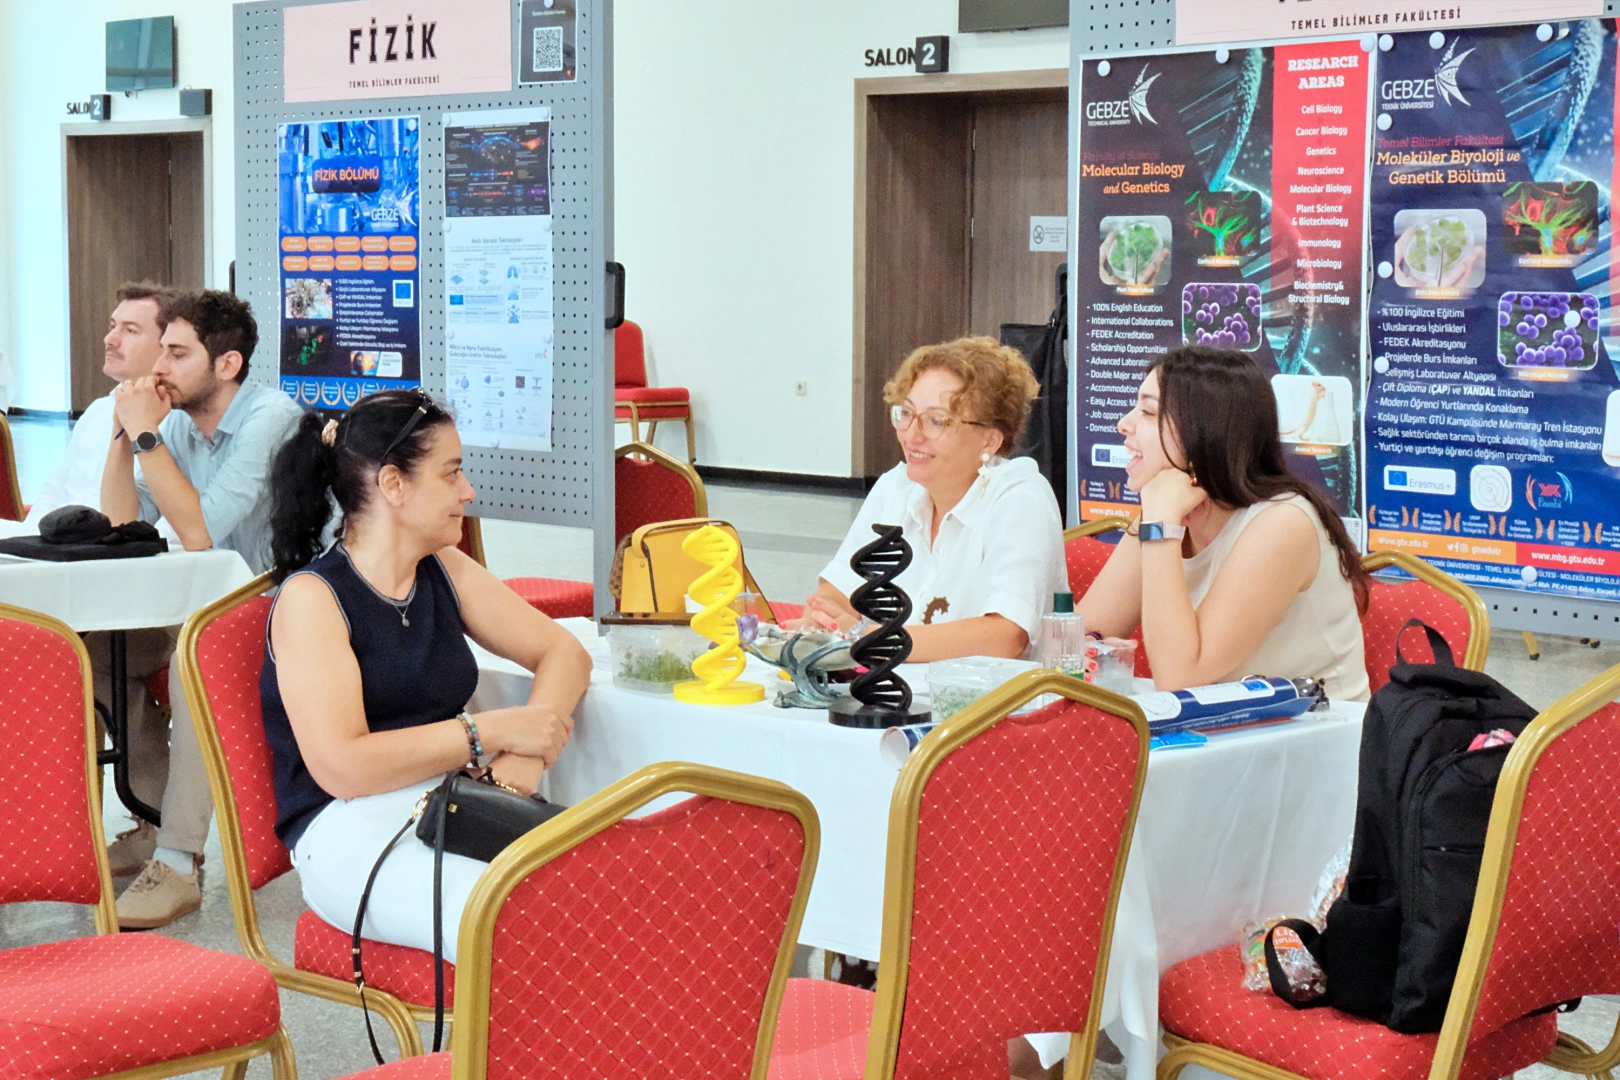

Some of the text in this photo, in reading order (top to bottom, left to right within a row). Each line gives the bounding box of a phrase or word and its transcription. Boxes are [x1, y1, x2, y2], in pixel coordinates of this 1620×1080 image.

[1291, 6, 1462, 30] TEMEL BİLİMLER FAKÜLTESİ
[349, 14, 438, 65] FİZİK
[864, 42, 936, 67] SALON 2
[1287, 55, 1359, 71] RESEARCH
[349, 75, 440, 88] TEMEL BİLİMLER FAKÜLTESİ
[1298, 75, 1345, 89] AREAS
[1381, 79, 1435, 100] GEBZE
[66, 98, 101, 116] SALO 2
[1086, 101, 1130, 119] GEBZE
[1301, 104, 1342, 114] Cell Biology
[1382, 100, 1434, 110] TEKNİK ÜNİVERSİTESİ
[1296, 126, 1348, 136] Cancer Biology
[1378, 134, 1504, 149] Temel Bilimler Fakültesi
[1306, 146, 1336, 156] Genetics
[1376, 148, 1521, 166] Moleküler Biyoloji ve
[315, 166, 380, 181] FİZİK BÖLÜMÜ
[1082, 162, 1185, 179] Molecular Biology
[1298, 166, 1344, 175] Neuroscience
[1389, 169, 1506, 185] Genetik Bölümü
[1103, 181, 1170, 194] and Genetics
[1290, 183, 1352, 194] Molecular Biology
[371, 208, 399, 221] GEBZE
[1296, 204, 1343, 213] Plant Science
[1291, 216, 1349, 227] & Biotechnology
[1298, 238, 1341, 248] Immunology
[1297, 259, 1342, 269] Microbiology
[1518, 257, 1541, 265] Konfokal
[1288, 294, 1350, 305] Structural Biology
[1092, 303, 1163, 313] 100% English Education
[1382, 306, 1465, 319] %100 İngilizce Eğitimi
[1091, 317, 1174, 327] International Collaborations
[1382, 321, 1466, 334] Uluslararası İşbirlikleri
[1114, 330, 1154, 339] Accreditation
[1091, 343, 1168, 354] Scholarship Opportunities
[1384, 337, 1466, 350] FEDEK Akreditasyonu
[1090, 356, 1120, 365] Advanced
[1385, 352, 1478, 365] Projelerde Burs İmkanları
[1090, 370, 1143, 380] Double Major and
[1416, 368, 1461, 380] Laboratuvar
[1463, 370, 1497, 382] Altyapısı
[1090, 383, 1138, 393] Accommodation
[1382, 382, 1395, 393] Çift
[1397, 382, 1427, 394] Diploma
[1428, 384, 1450, 395] (ÇAP)
[1463, 385, 1496, 396] YANDAL
[1497, 386, 1535, 399] İmkanları
[1090, 397, 1139, 407] Easy Access: Ma
[1380, 397, 1529, 414] Modern Öğrenci Yurtlarında Konaklama
[1090, 410, 1101, 419] Job
[1089, 423, 1118, 433] Domestic
[1378, 412, 1602, 435] Kolay Ulaşım: GTÜ Kampüsünde Marmaray Tren İstasyonu
[1378, 427, 1602, 451] Sağlık sektöründen tarıma birçok alanda iş bulma imkanları
[1379, 442, 1403, 453] Yurtiçi
[1404, 444, 1413, 453] ve
[1415, 445, 1444, 456] yurtdışı
[1445, 446, 1473, 457] öğrenci
[1474, 448, 1505, 460] değişim
[1112, 456, 1131, 465] Eras
[1538, 496, 1562, 508] Farabi
[1378, 538, 1606, 566] www.gtu.edu.tr gtuedutr www.mbg.gtu.edu.tr
[1446, 561, 1481, 571] ÜNİVERSİTESİ
[1485, 565, 1502, 574] TEMEL
[1560, 573, 1595, 583] MOLEKÜLER
